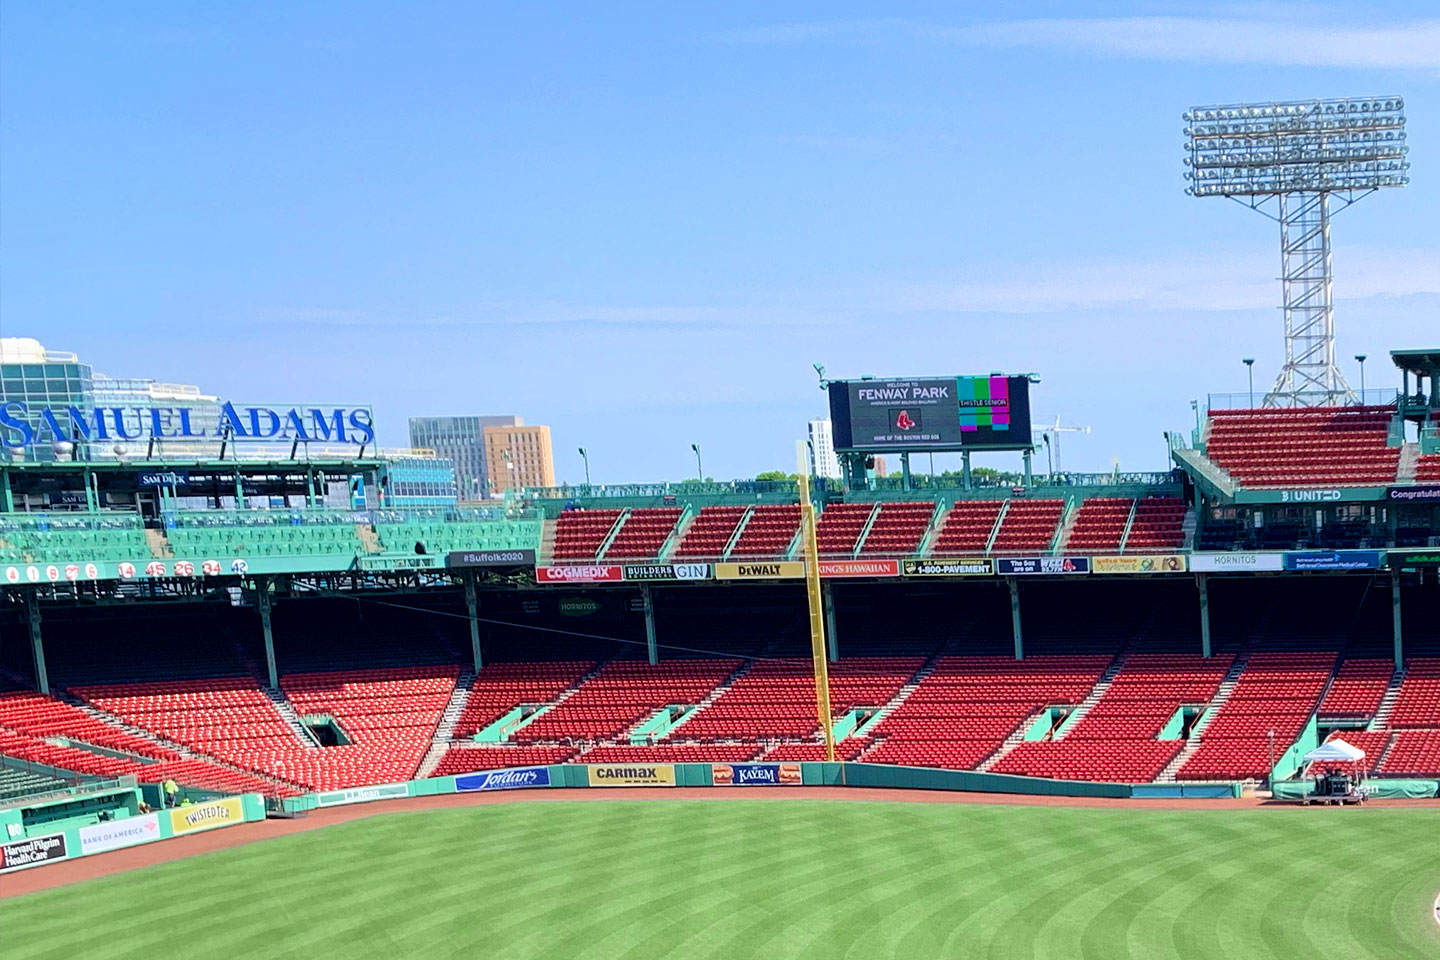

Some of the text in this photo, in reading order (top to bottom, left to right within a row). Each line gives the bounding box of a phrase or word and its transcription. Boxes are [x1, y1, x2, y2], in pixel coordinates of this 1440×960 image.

[858, 387, 949, 400] FENWAY PARK
[0, 400, 375, 448] SAMUEL ADAMS
[143, 475, 161, 485] SAM
[463, 552, 524, 563] #Suffolk2020
[1214, 555, 1256, 565] HORNITOS
[119, 565, 135, 577] 14
[146, 563, 166, 575] 45
[174, 562, 194, 575] 26
[202, 562, 221, 574] 34
[233, 561, 247, 573] 42
[546, 566, 610, 578] COGMEDIX
[628, 566, 673, 575] BUILDERS
[676, 566, 704, 578] GIN
[738, 564, 781, 576] DEWALT
[845, 563, 891, 573] HAWAIIAN
[917, 565, 990, 573] 1-800-PAVEMENT
[596, 767, 657, 779] CARMAX
[739, 769, 775, 783] KAYEM
[480, 771, 537, 788] Jordan's
[185, 805, 231, 827] TWISTED TEA
[83, 836, 102, 845] BANK
[113, 827, 144, 840] AMERICA
[4, 837, 61, 857] Harvard Pilgrim
[5, 851, 48, 867] Health Care
